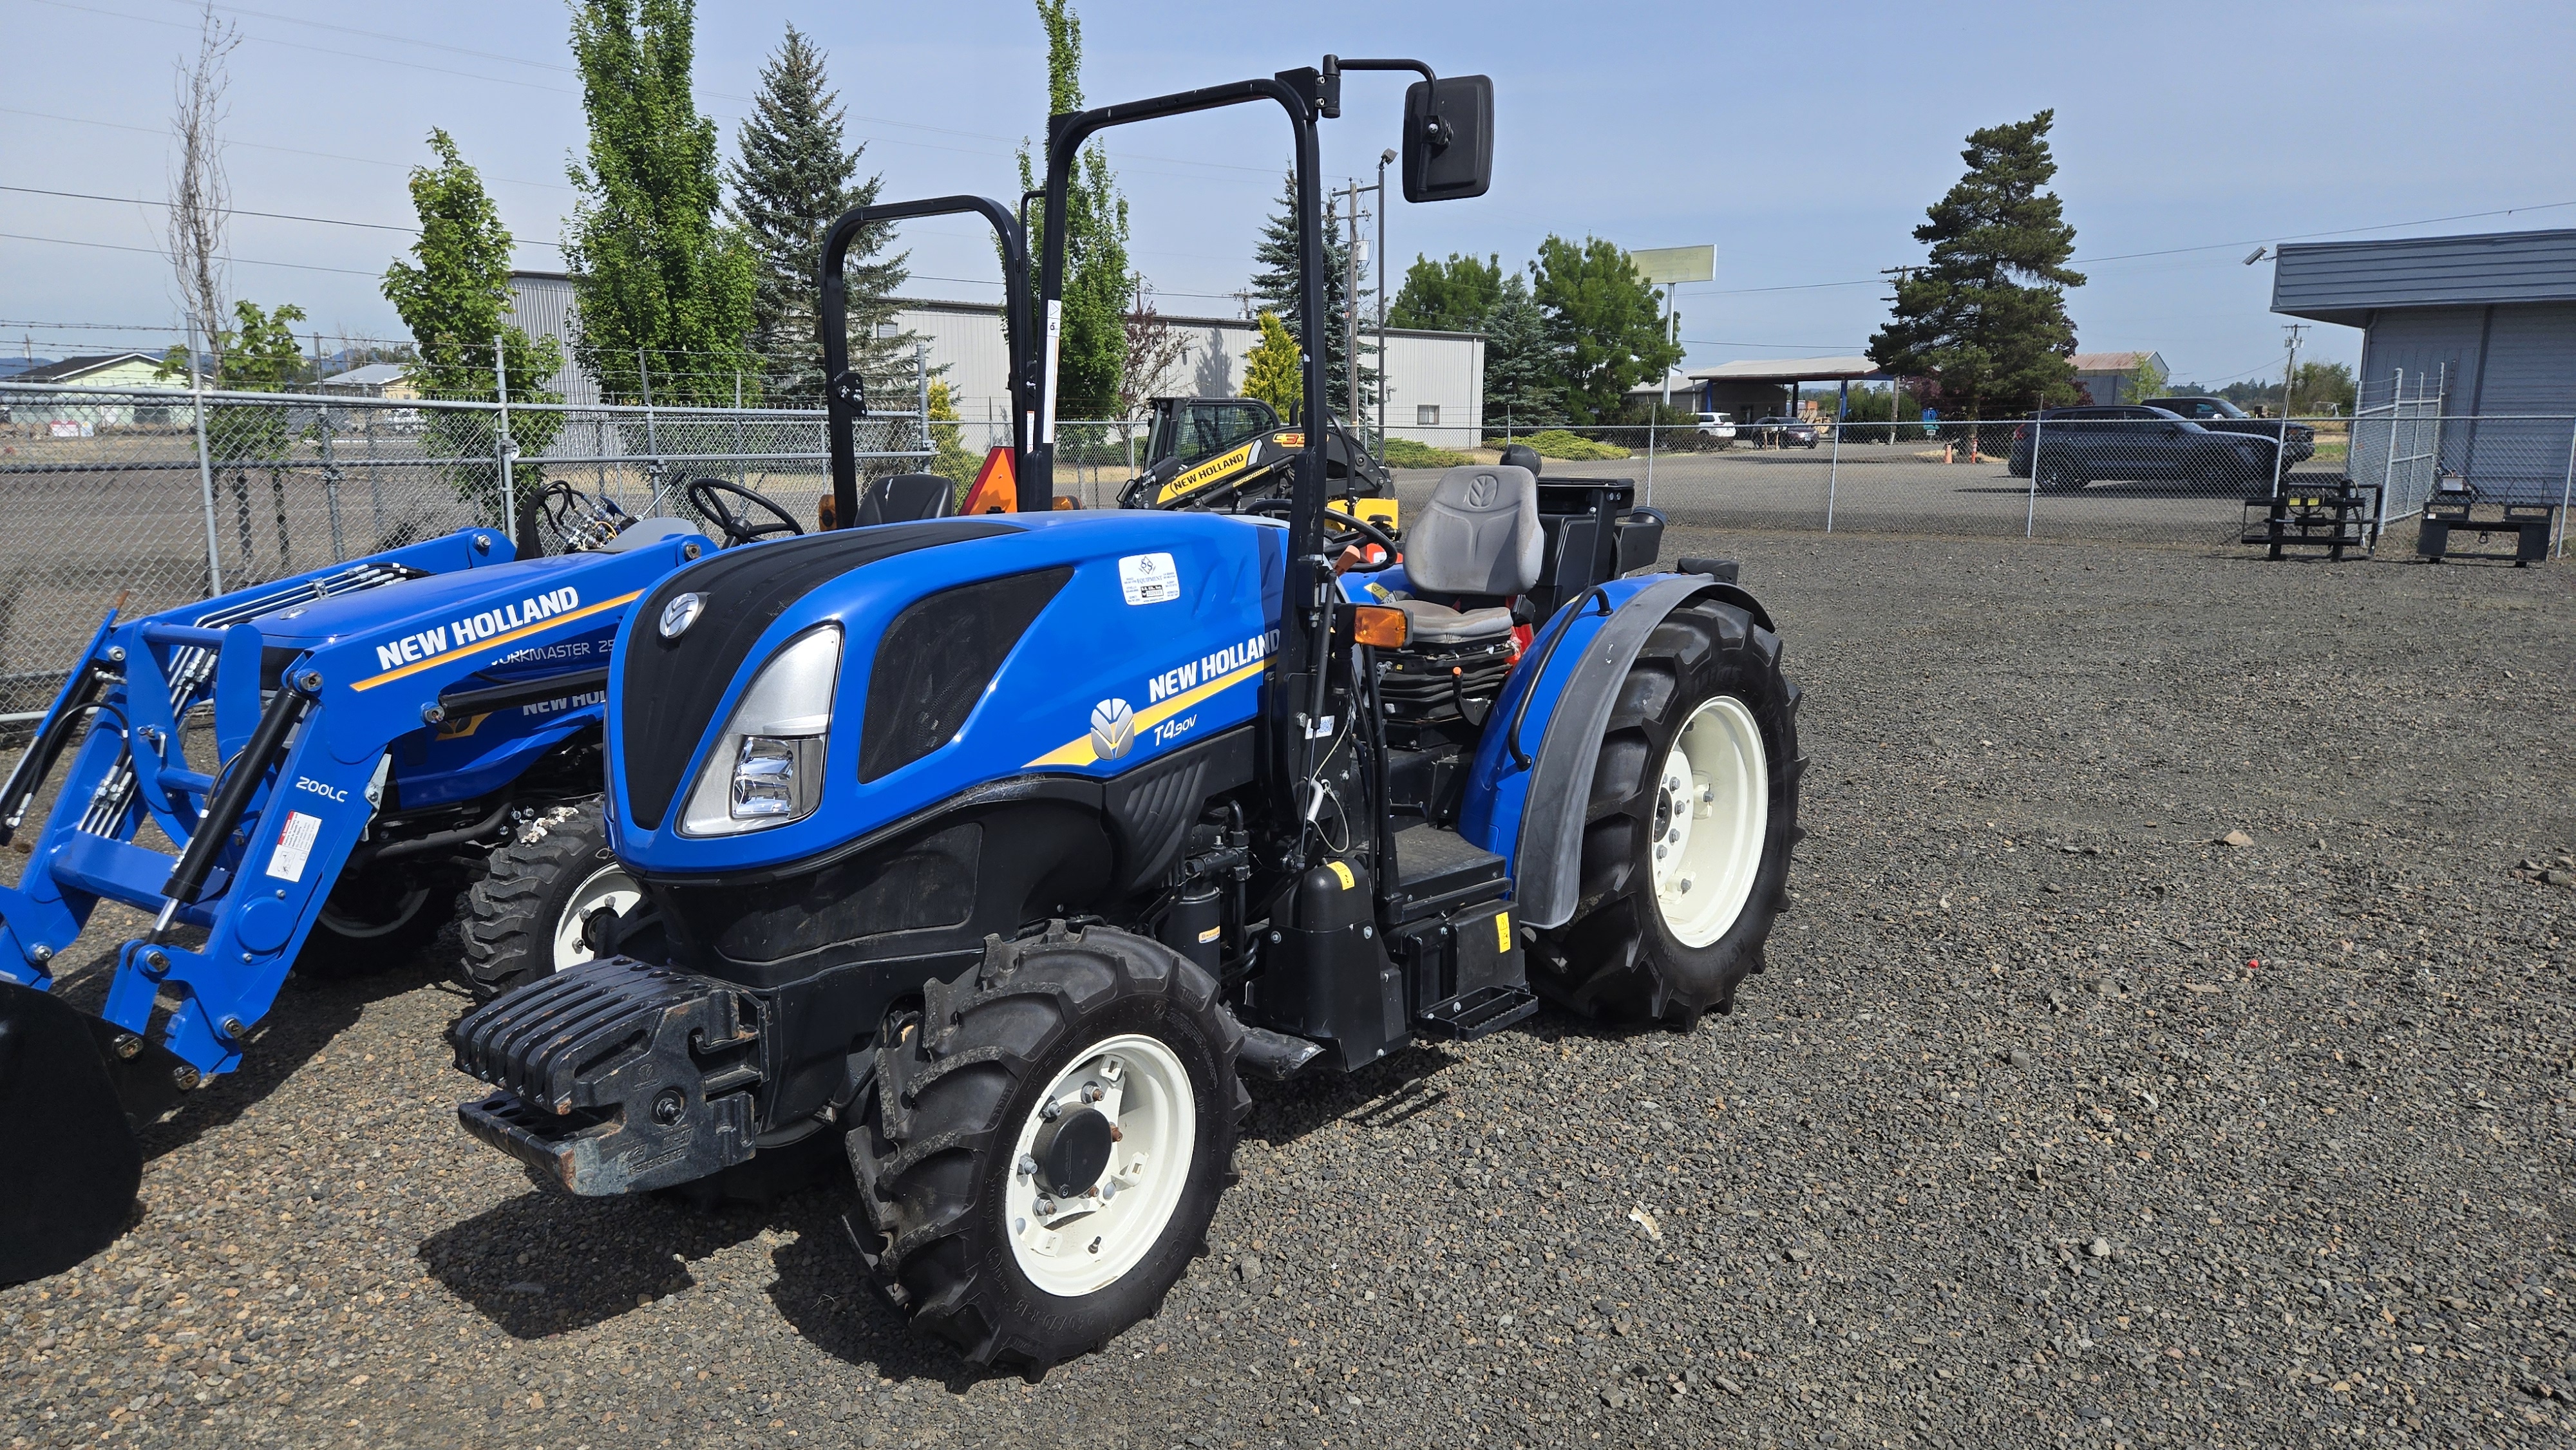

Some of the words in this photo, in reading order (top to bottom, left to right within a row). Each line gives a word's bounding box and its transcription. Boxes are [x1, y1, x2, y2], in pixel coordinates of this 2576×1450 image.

[1173, 474, 1197, 491] NEW
[1198, 453, 1244, 479] HOLLAND
[1137, 576, 1162, 584] EQUIPMENT
[376, 626, 447, 670] NEW
[451, 586, 580, 646] HOLLAND
[491, 643, 591, 666] ORKMASTER
[1149, 661, 1198, 703] NEW
[1202, 628, 1280, 681] HOLLAND
[523, 697, 567, 716] NEW
[572, 690, 606, 707] HOL
[296, 776, 348, 803] 200LC
